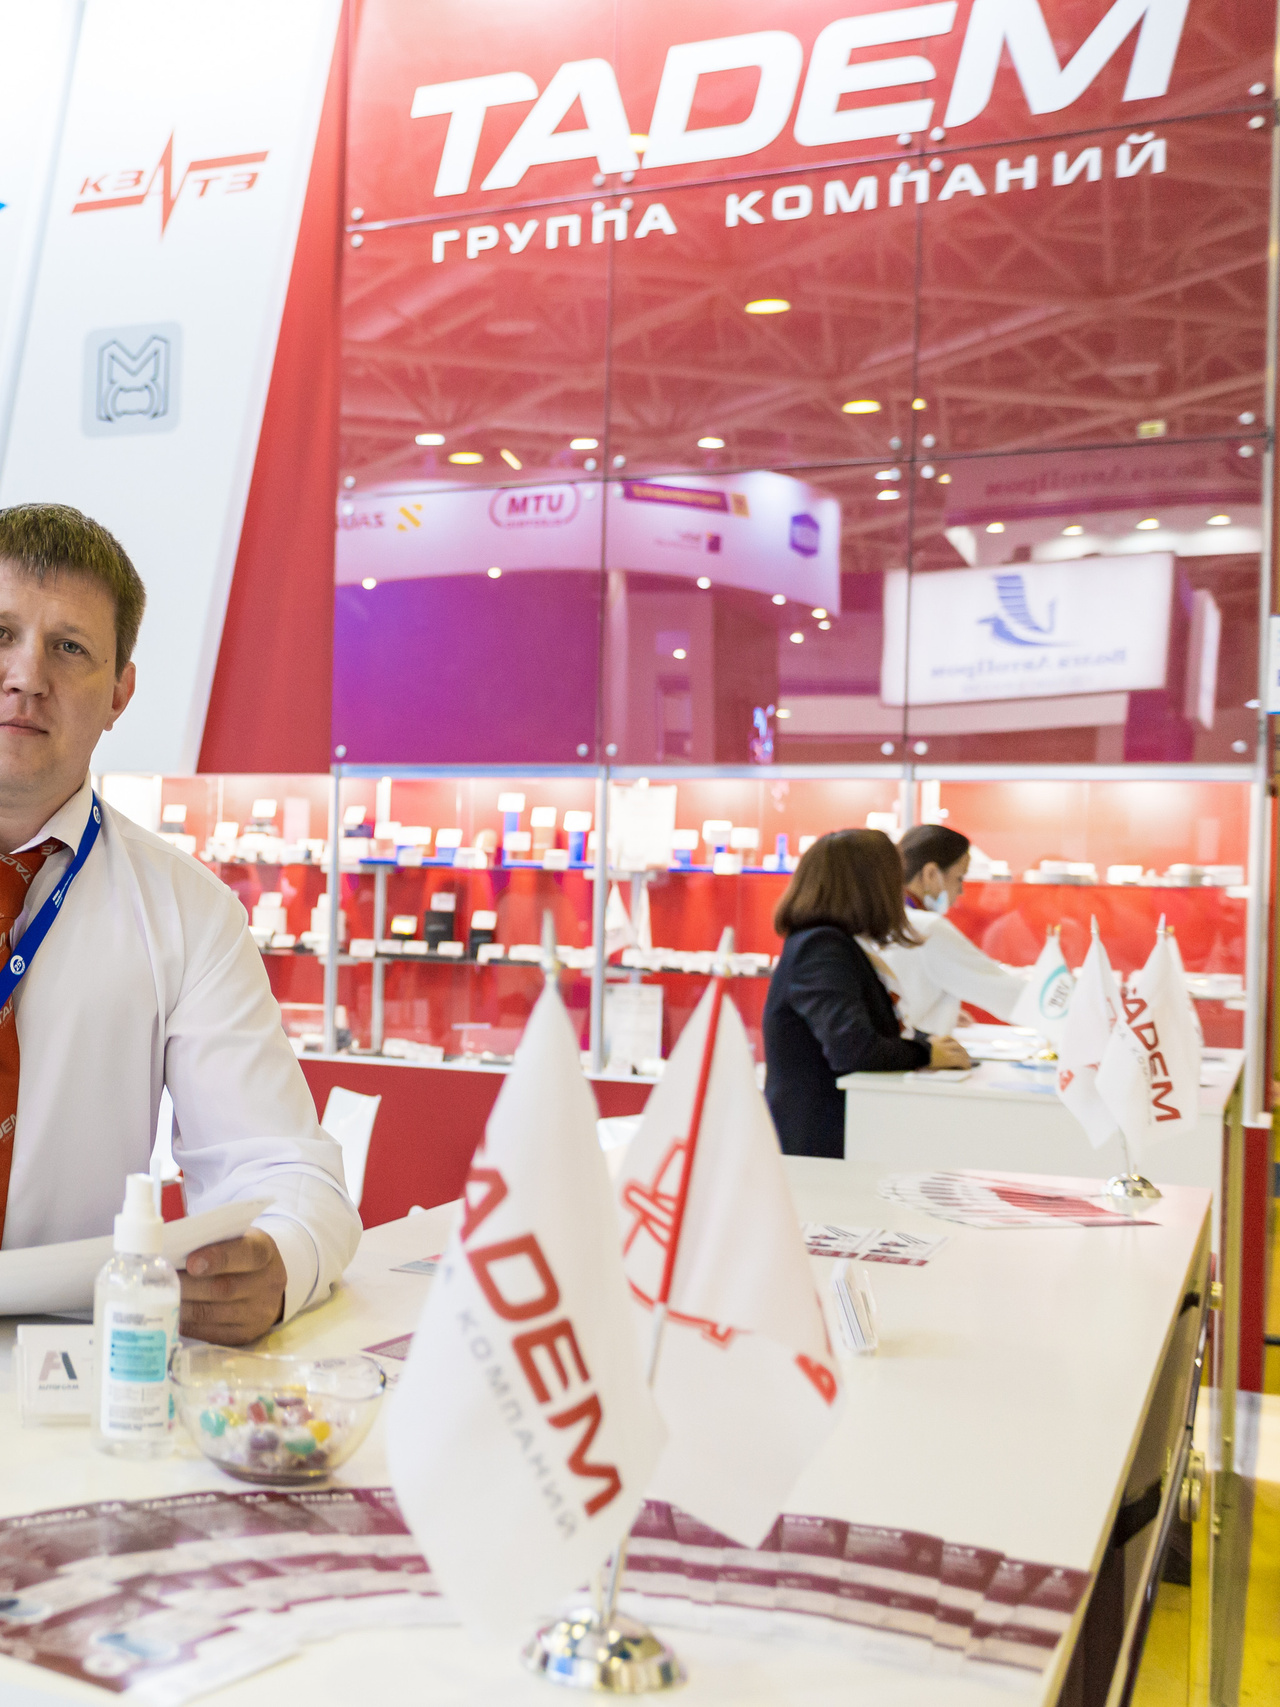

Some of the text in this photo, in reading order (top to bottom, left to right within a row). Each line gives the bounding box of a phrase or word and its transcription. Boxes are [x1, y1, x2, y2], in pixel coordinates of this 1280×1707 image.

[410, 0, 1191, 198] TADEM
[431, 131, 1168, 264] ГРУППА КОМПАНИЙ
[1122, 997, 1183, 1122] ADEM
[457, 1310, 579, 1540] КОМПАНИЙ
[460, 1167, 623, 1518] ADEM
